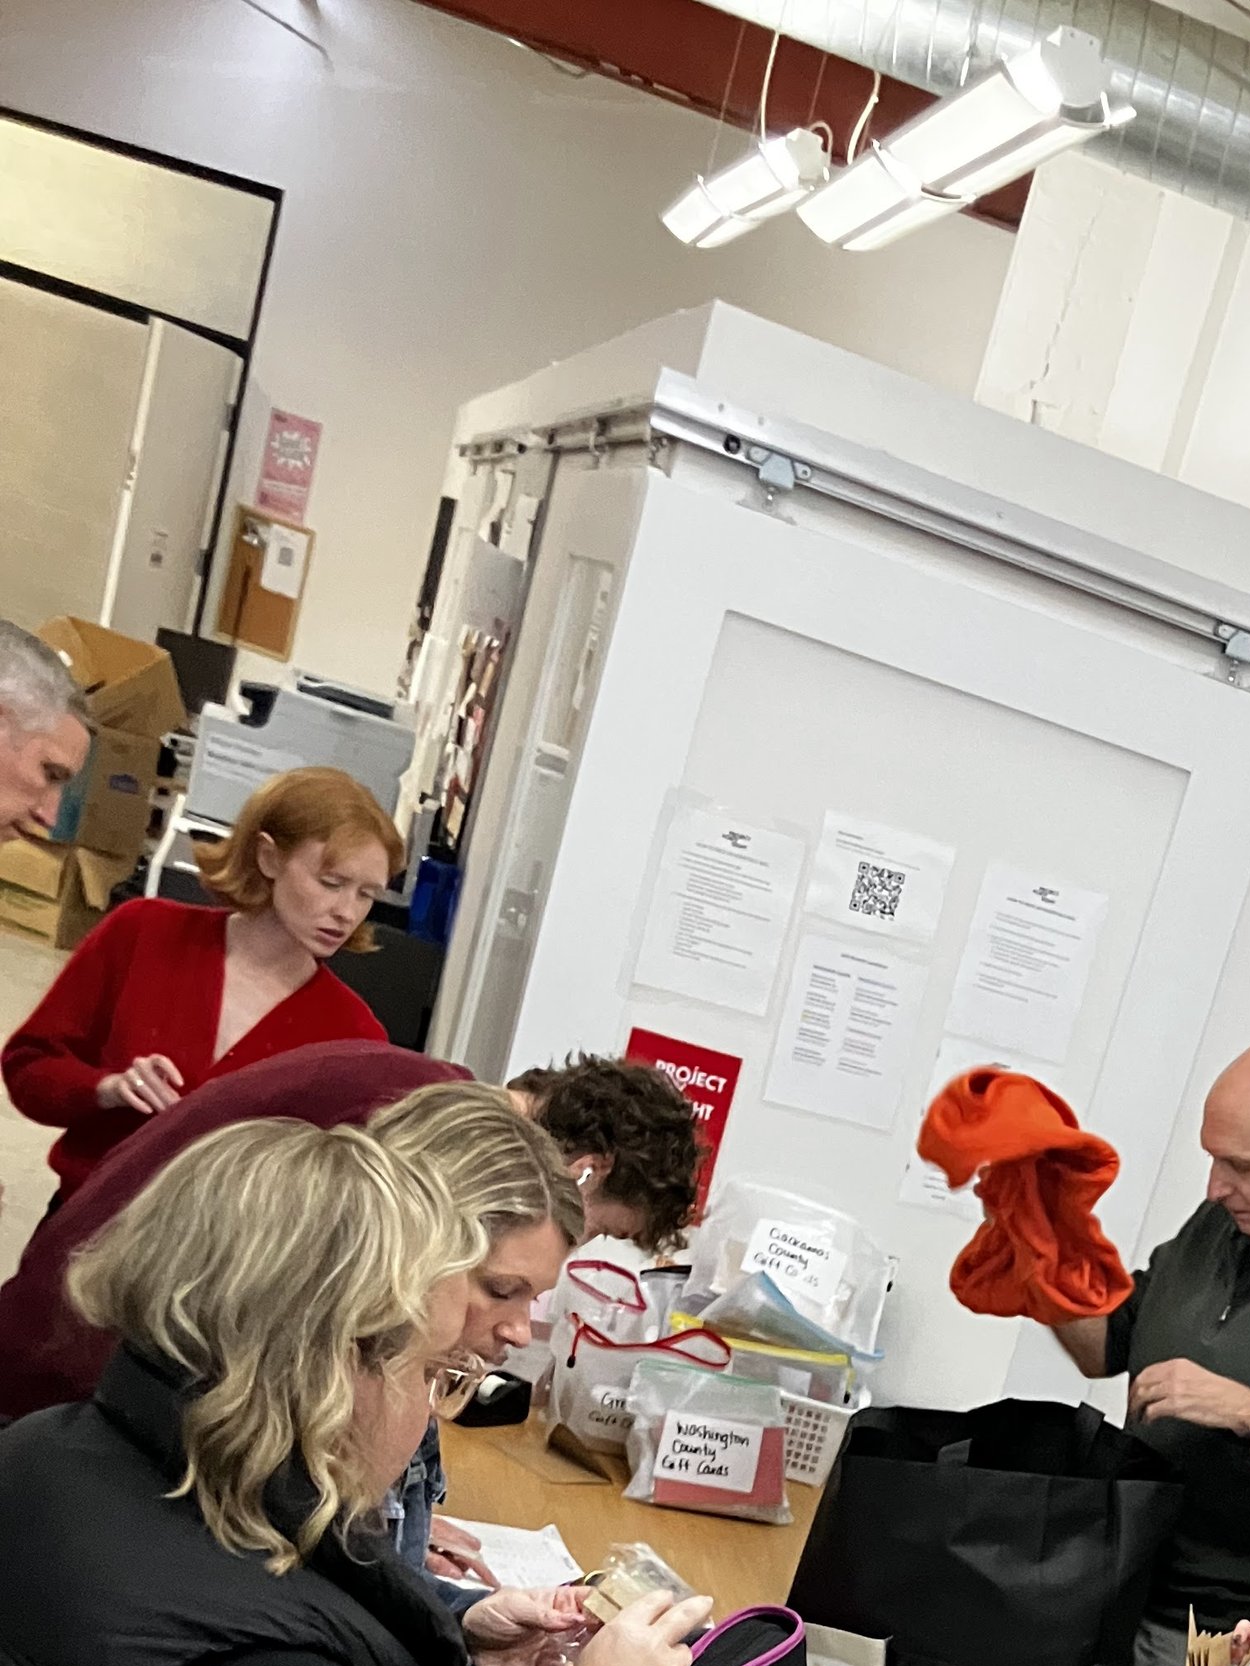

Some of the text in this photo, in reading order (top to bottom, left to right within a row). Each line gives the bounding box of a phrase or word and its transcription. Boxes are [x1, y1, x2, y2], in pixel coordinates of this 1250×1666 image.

[768, 1242, 809, 1270] County
[785, 1264, 819, 1288] Cads
[672, 1439, 717, 1463] County
[661, 1454, 729, 1477] Gift Cards
